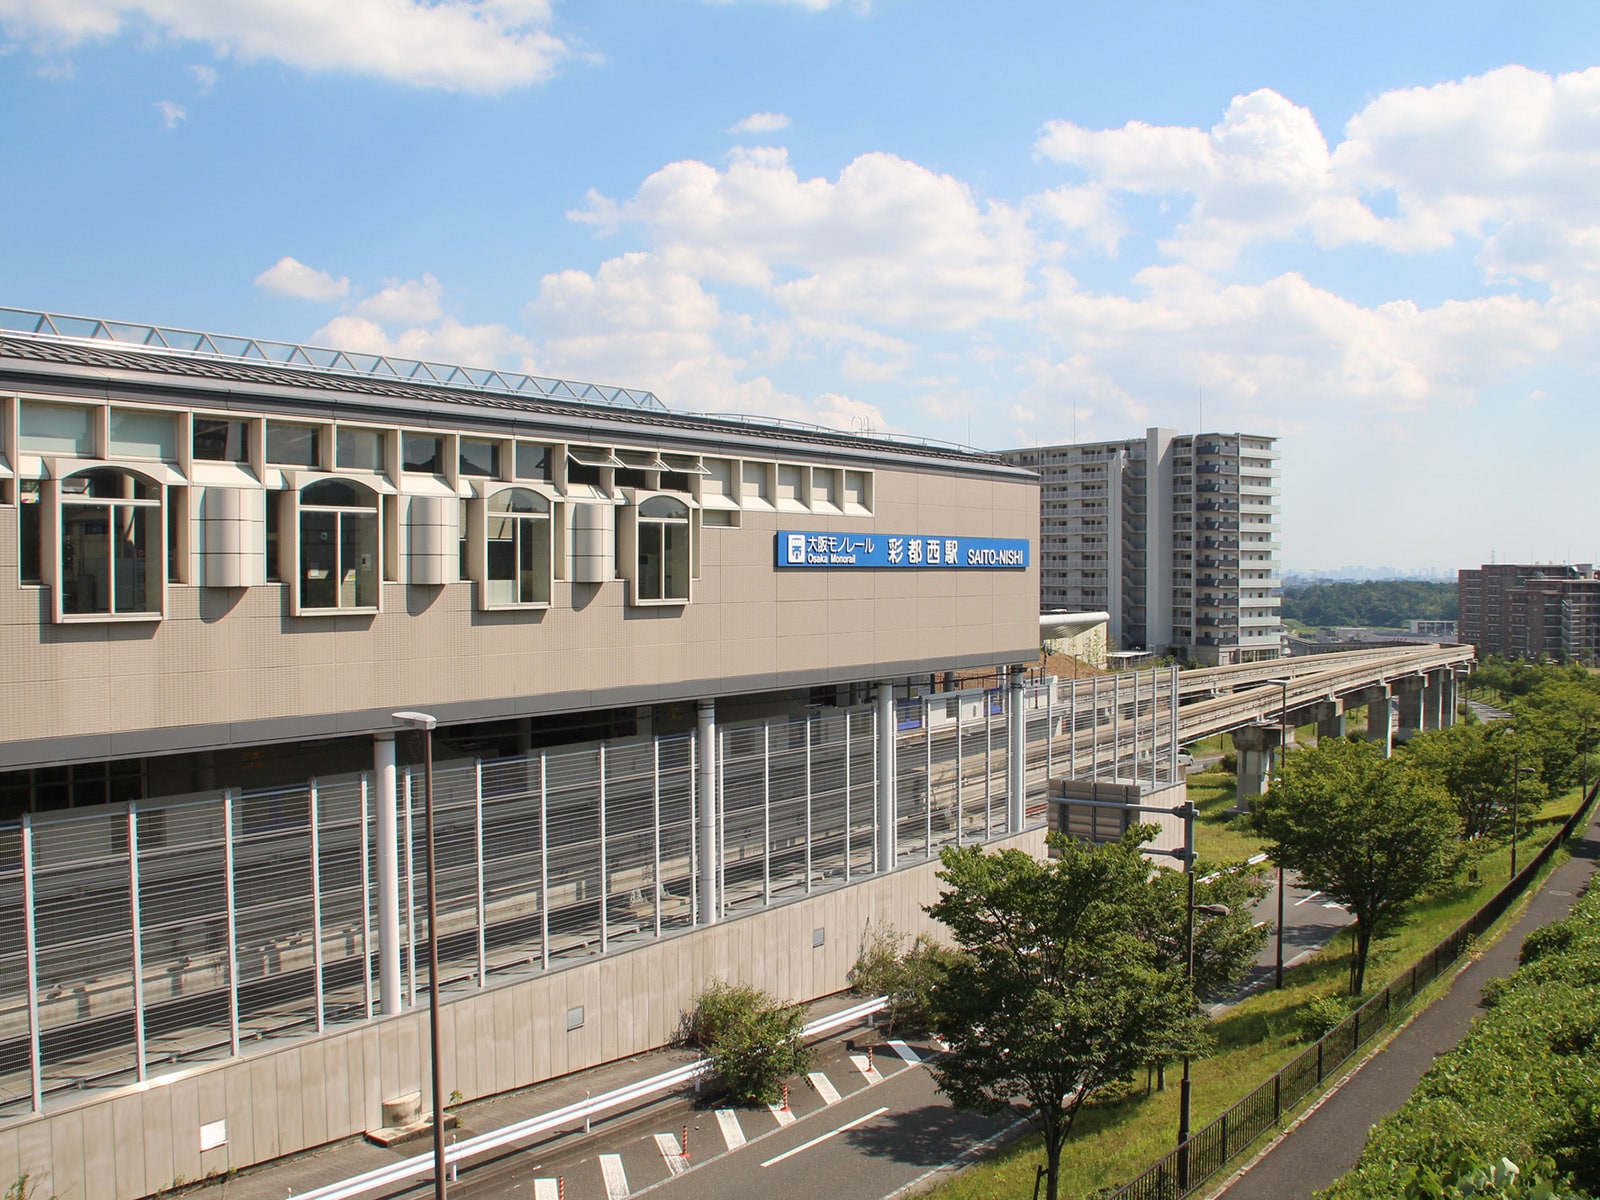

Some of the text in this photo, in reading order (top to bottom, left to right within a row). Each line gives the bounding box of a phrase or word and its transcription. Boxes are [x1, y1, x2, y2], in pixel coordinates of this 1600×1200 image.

[807, 535, 875, 553] 大阪モノレール
[888, 538, 958, 564] 彩都西駅
[808, 553, 856, 564] Osaka Monorail
[967, 549, 1023, 565] SAITO-NISHI
